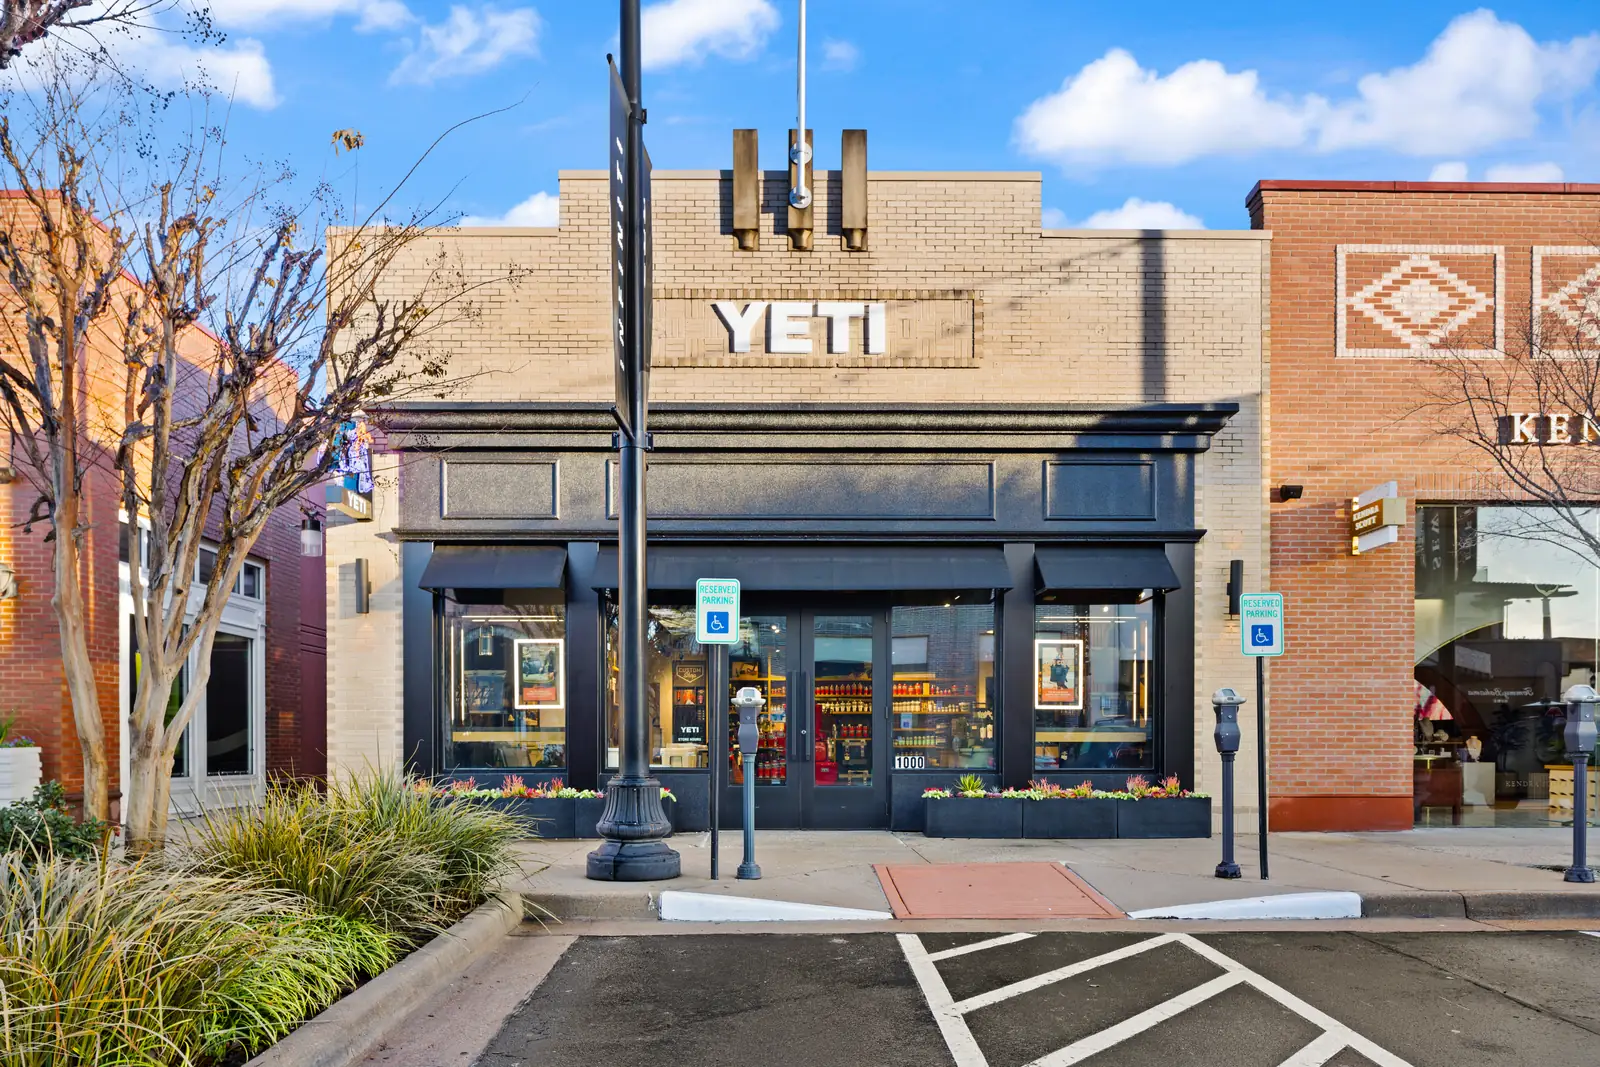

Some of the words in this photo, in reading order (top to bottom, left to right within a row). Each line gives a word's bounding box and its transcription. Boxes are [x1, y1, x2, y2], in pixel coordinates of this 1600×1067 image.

[713, 300, 886, 354] YETI
[347, 490, 367, 515] YETI
[1352, 504, 1380, 521] KENDRA
[1354, 515, 1378, 531] SCOTT
[699, 584, 737, 594] RESERVED
[702, 595, 734, 605] PARKING
[1243, 599, 1280, 608] RESERVED
[1245, 609, 1278, 618] PARKING
[683, 671, 697, 680] Shop
[896, 756, 924, 769] 1000
